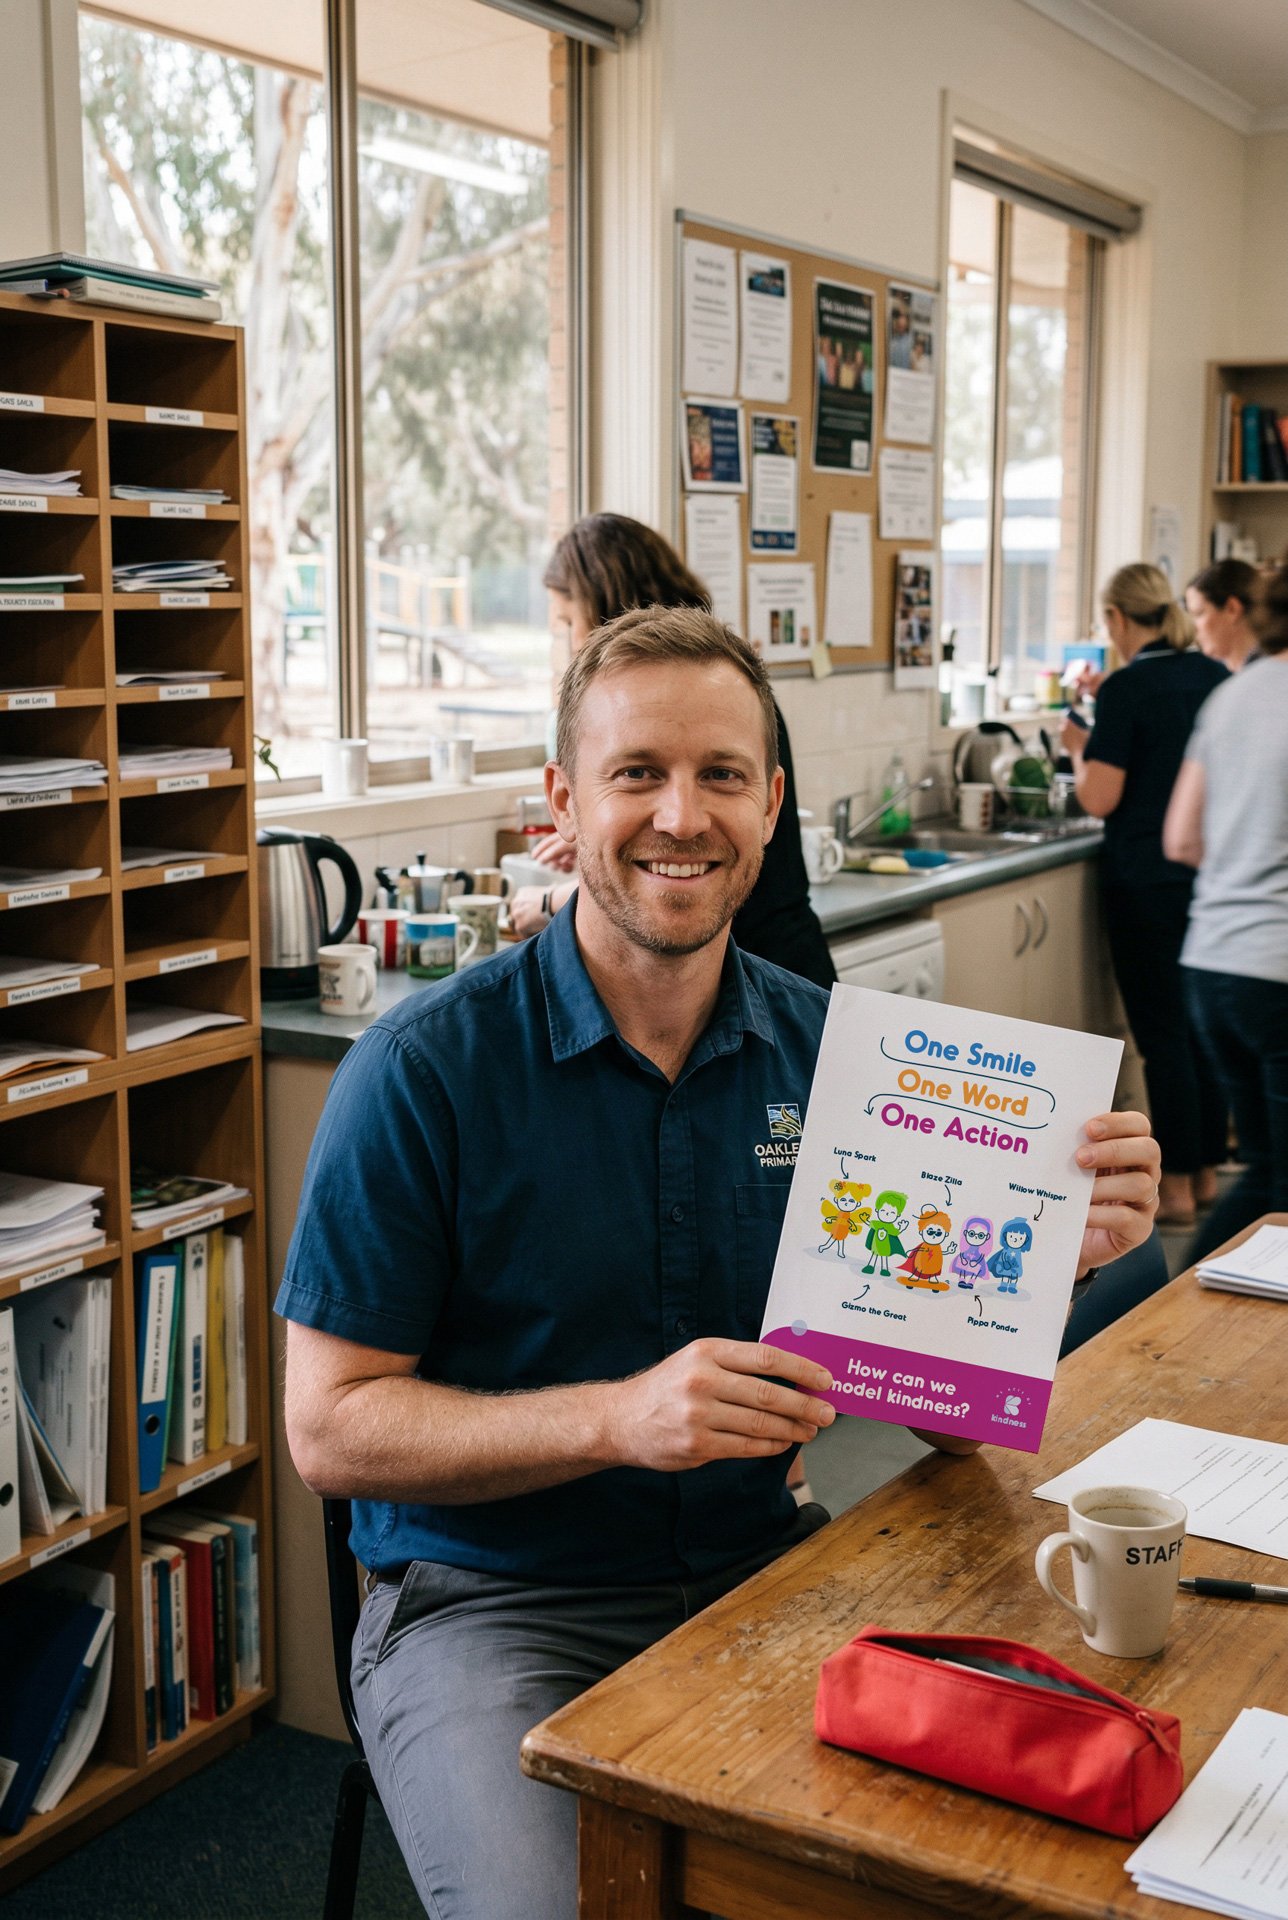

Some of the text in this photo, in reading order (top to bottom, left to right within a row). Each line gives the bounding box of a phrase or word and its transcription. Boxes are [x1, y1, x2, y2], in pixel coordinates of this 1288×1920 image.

[905, 1030, 1036, 1077] One Smile
[898, 1069, 1029, 1116] One Word
[881, 1103, 1029, 1154] One Action
[833, 1147, 877, 1162] Luna Spark
[921, 1171, 962, 1186] Blaze Zilla
[1009, 1182, 1067, 1201] Willow Whisper
[841, 1301, 907, 1321] Gizmo the Great
[967, 1316, 1019, 1333] Pippa Ponder
[847, 1358, 956, 1395] How can we
[886, 1388, 970, 1418] kindness?
[991, 1413, 1027, 1428] kindness
